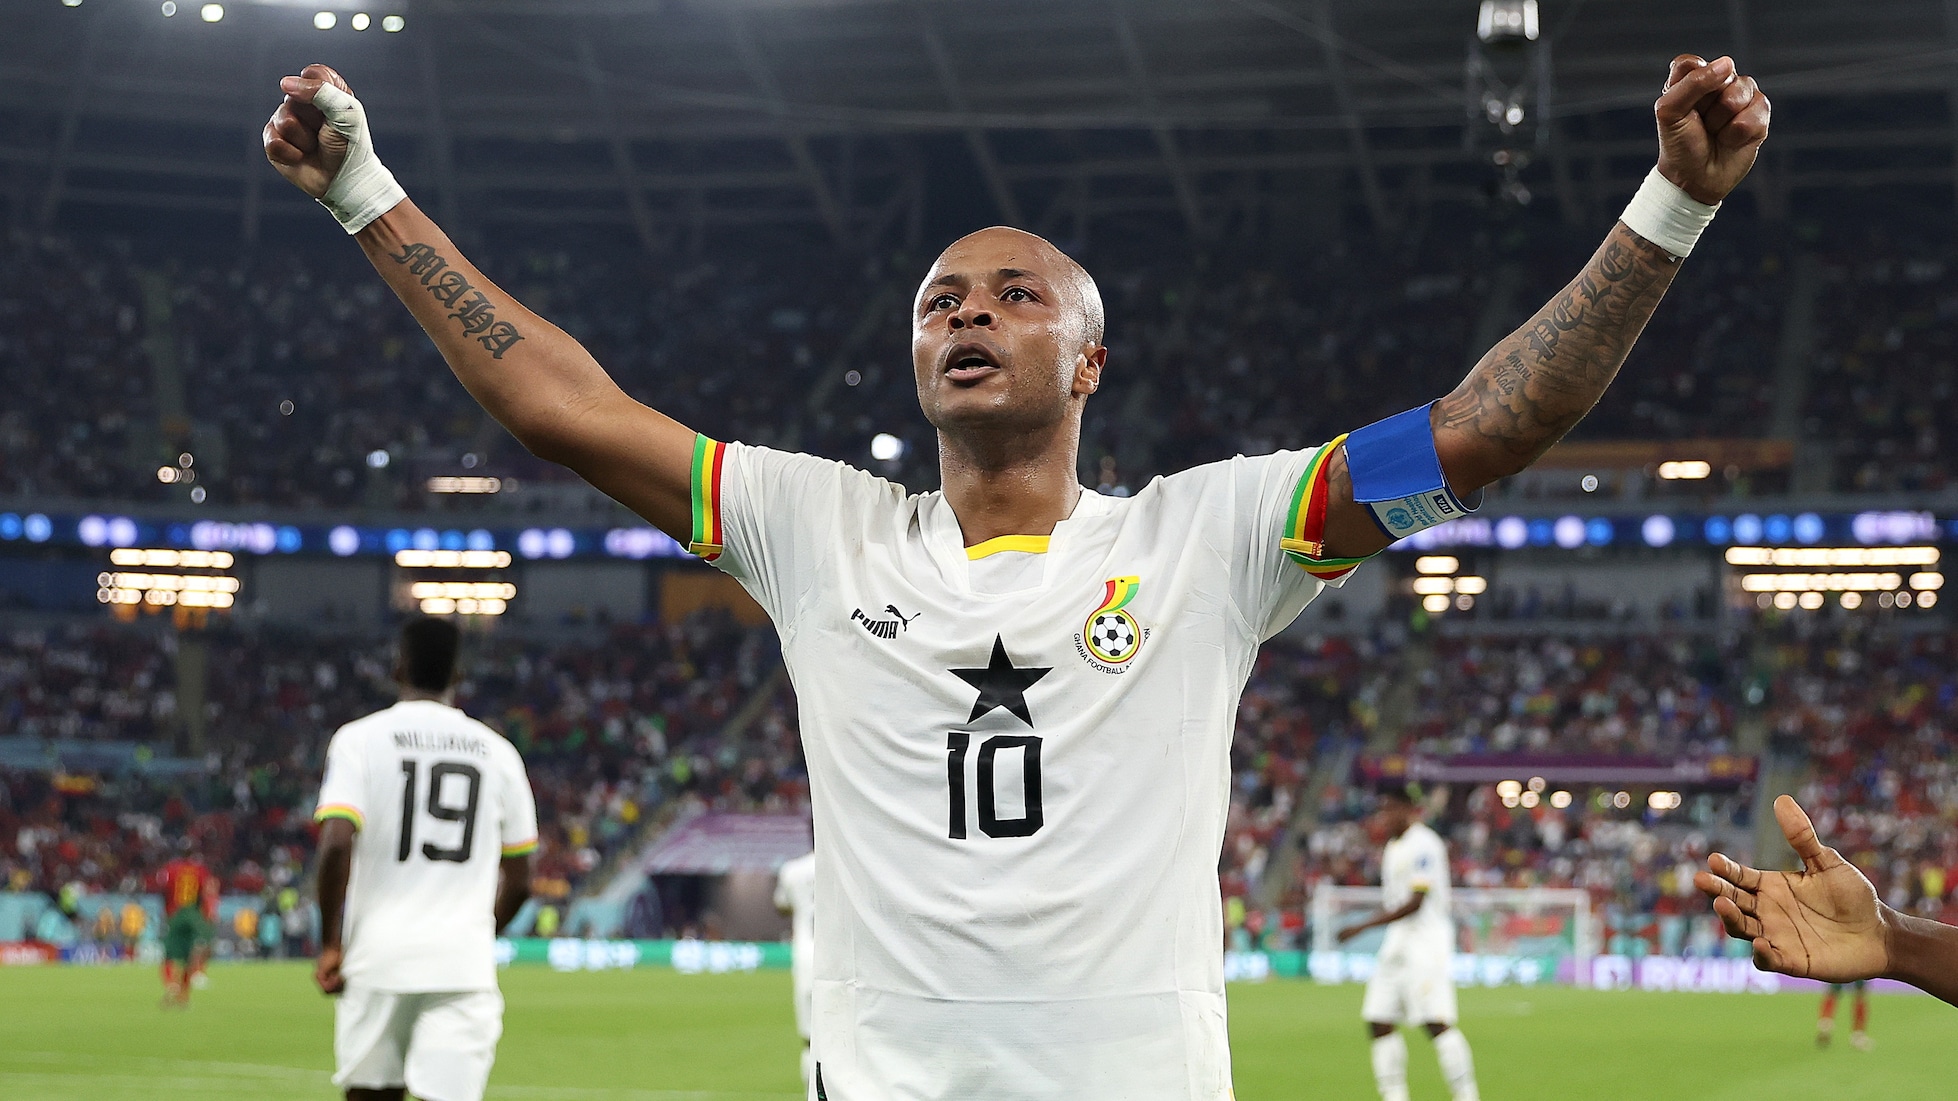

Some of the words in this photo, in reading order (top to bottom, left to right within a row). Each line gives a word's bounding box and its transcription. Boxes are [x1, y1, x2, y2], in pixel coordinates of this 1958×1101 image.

[388, 242, 526, 360] MAHA
[1436, 497, 1453, 513] FIFA
[851, 607, 899, 640] PUMA
[1073, 632, 1089, 661] GHANA
[1086, 657, 1126, 675] FOOTBALL
[398, 758, 481, 864] 19
[946, 731, 1045, 840] 10
